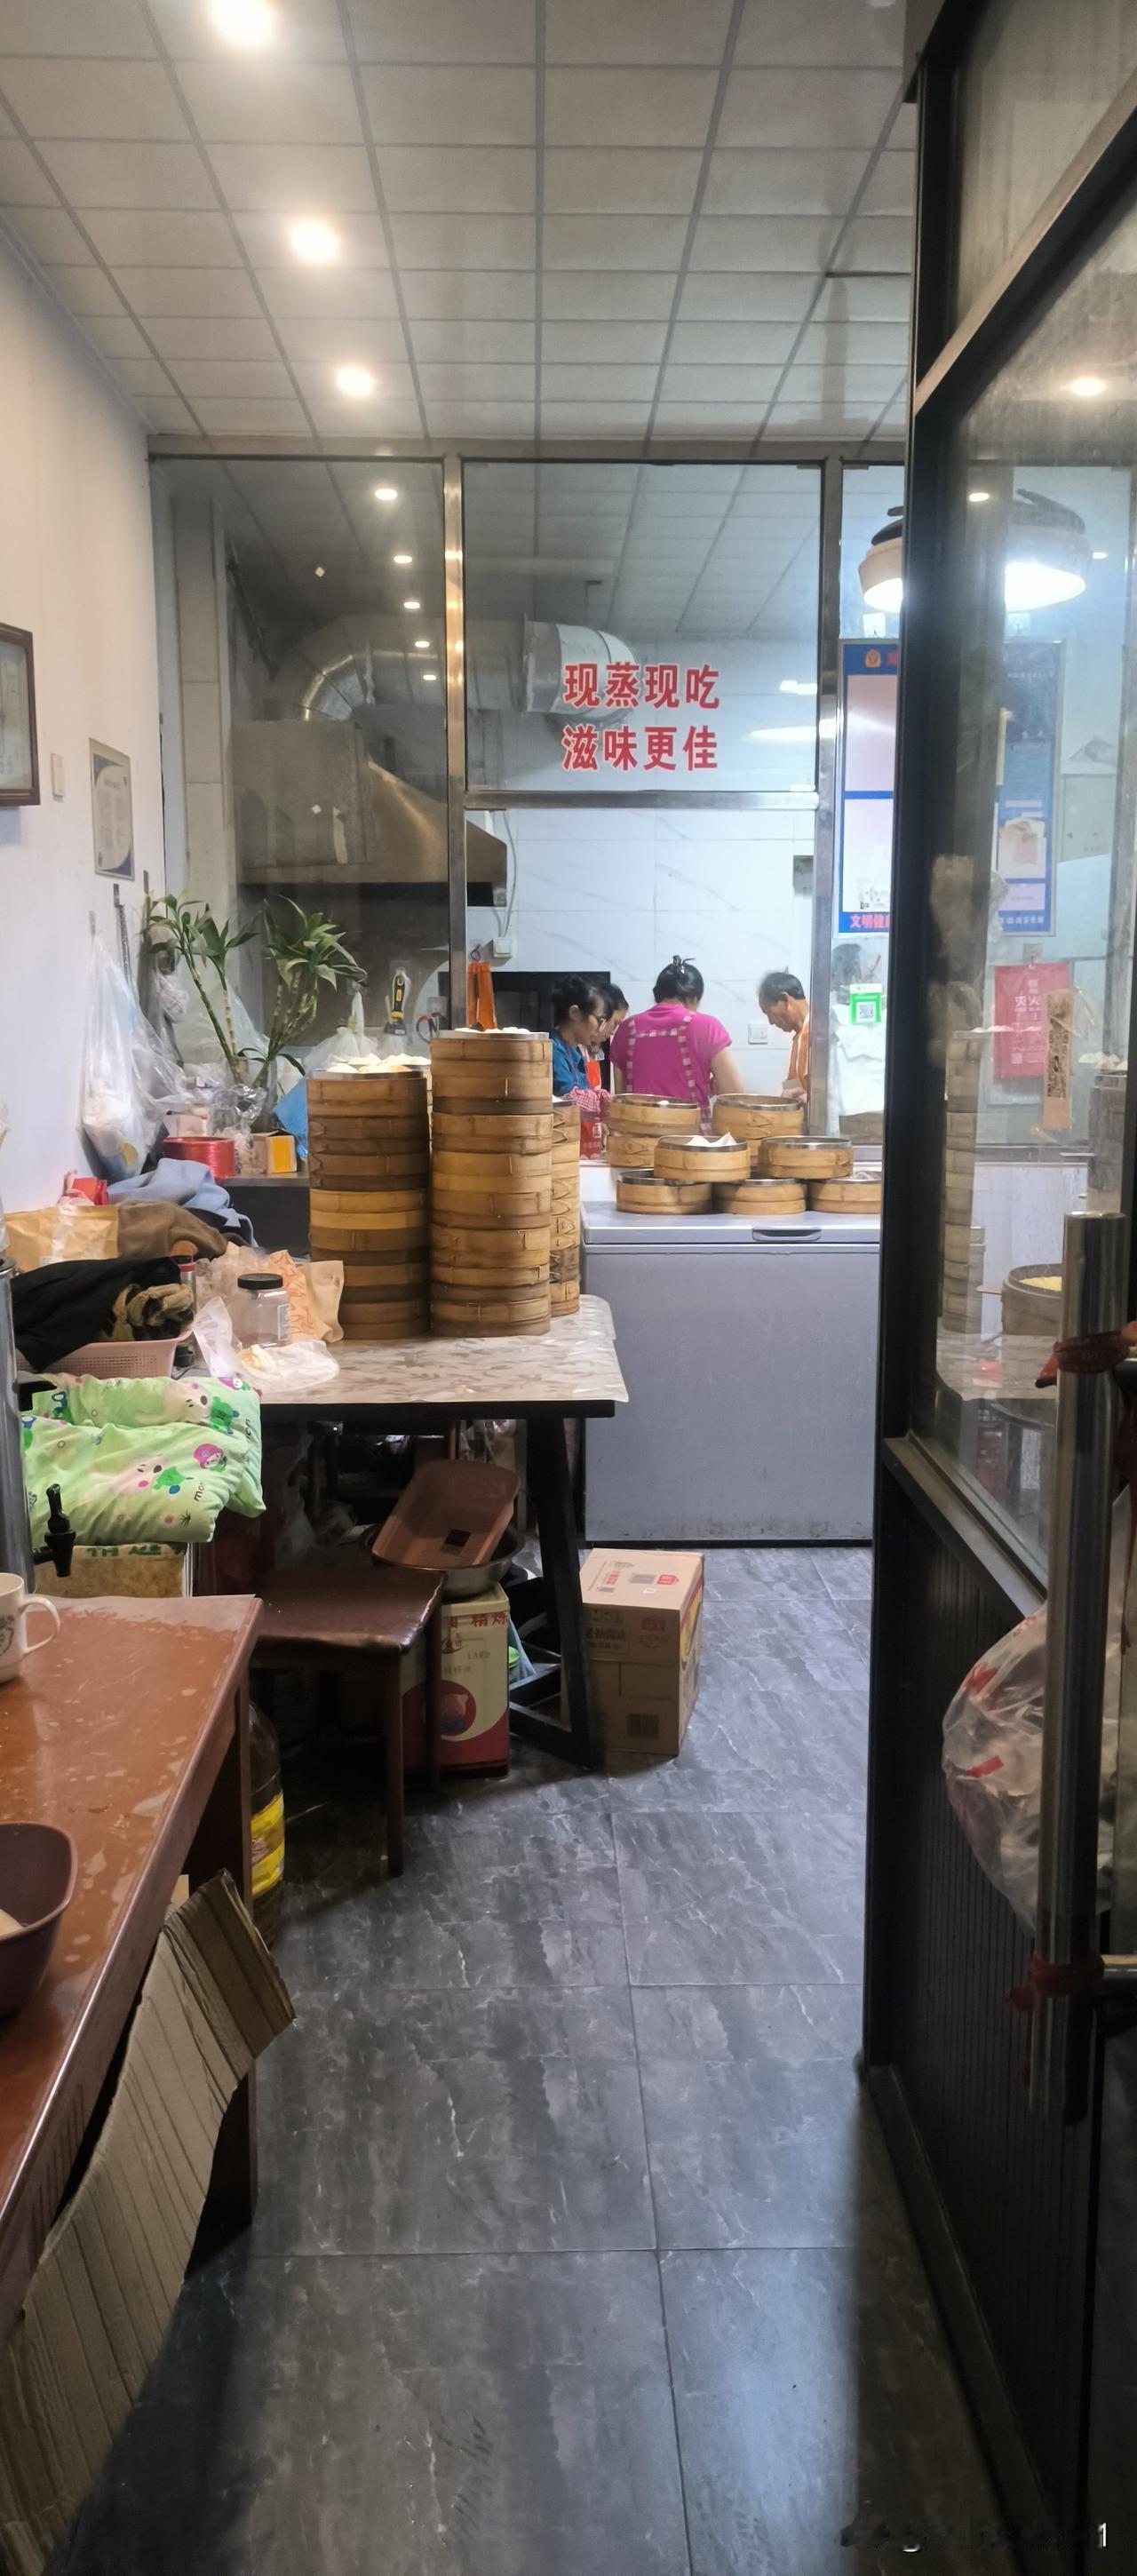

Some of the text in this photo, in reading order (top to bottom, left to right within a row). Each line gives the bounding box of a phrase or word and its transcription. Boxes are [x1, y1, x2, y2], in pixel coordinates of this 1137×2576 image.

[562, 662, 720, 710] 现蒸现吃
[561, 724, 719, 772] 滋味更佳
